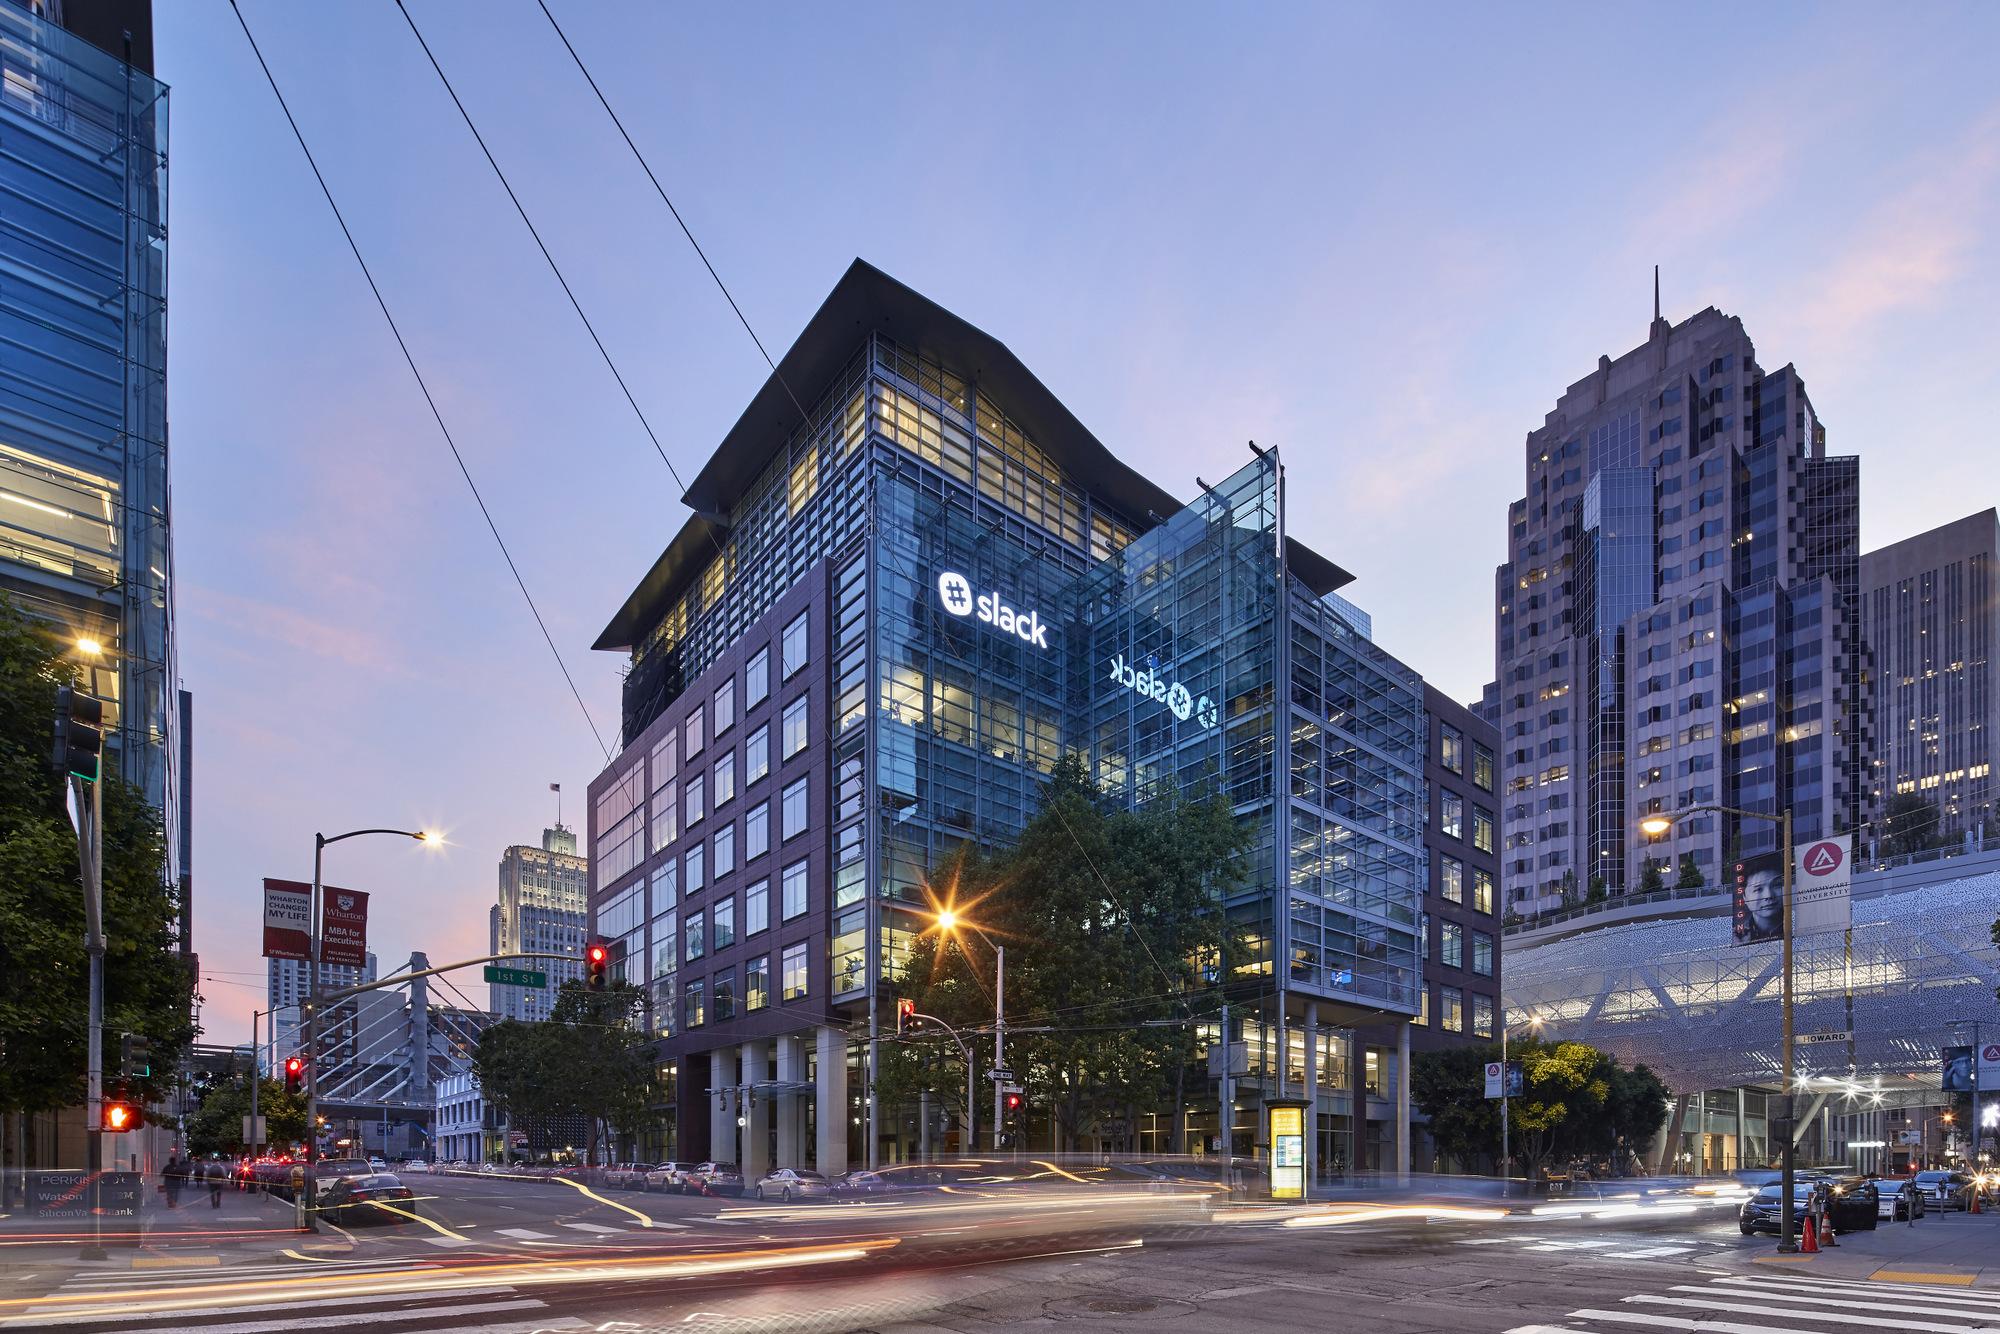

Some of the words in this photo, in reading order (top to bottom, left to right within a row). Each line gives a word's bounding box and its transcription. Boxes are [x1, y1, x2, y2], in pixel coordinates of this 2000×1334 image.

[977, 591, 1048, 649] slack
[269, 895, 308, 905] WHARTON
[1736, 864, 1744, 931] DESIGN
[1796, 889, 1849, 902] UNIVERSITY
[268, 901, 308, 912] CHANGED
[268, 909, 285, 919] MY
[326, 907, 364, 920] Wharton
[328, 926, 347, 936] MBA
[349, 928, 360, 938] for
[324, 934, 364, 947] Executives
[328, 950, 359, 958] PHILADELPHIA
[497, 970, 514, 982] 1st
[521, 974, 535, 985] St
[1803, 1033, 1846, 1043] HOWARD
[38, 1193, 83, 1201] Watson
[39, 1209, 74, 1218] Silicon
